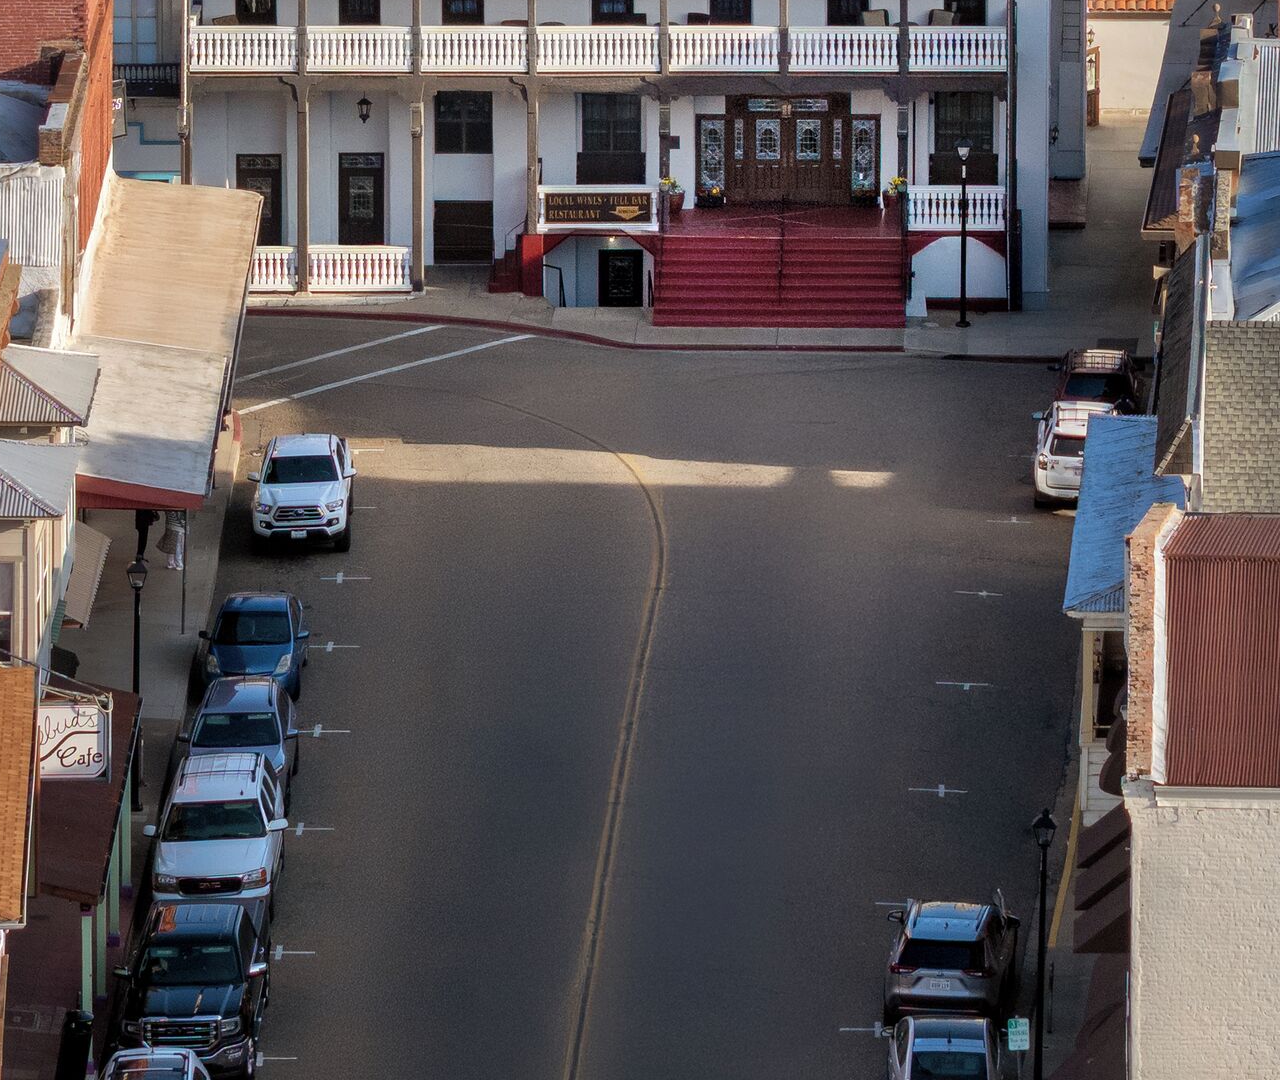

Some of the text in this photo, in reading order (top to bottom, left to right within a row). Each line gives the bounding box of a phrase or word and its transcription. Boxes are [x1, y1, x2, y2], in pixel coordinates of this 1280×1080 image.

[548, 195, 574, 206] LOCAL
[610, 195, 630, 205] FULL
[631, 195, 648, 205] BAR
[548, 209, 600, 219] RESTAURANT
[56, 746, 103, 768] Cafe
